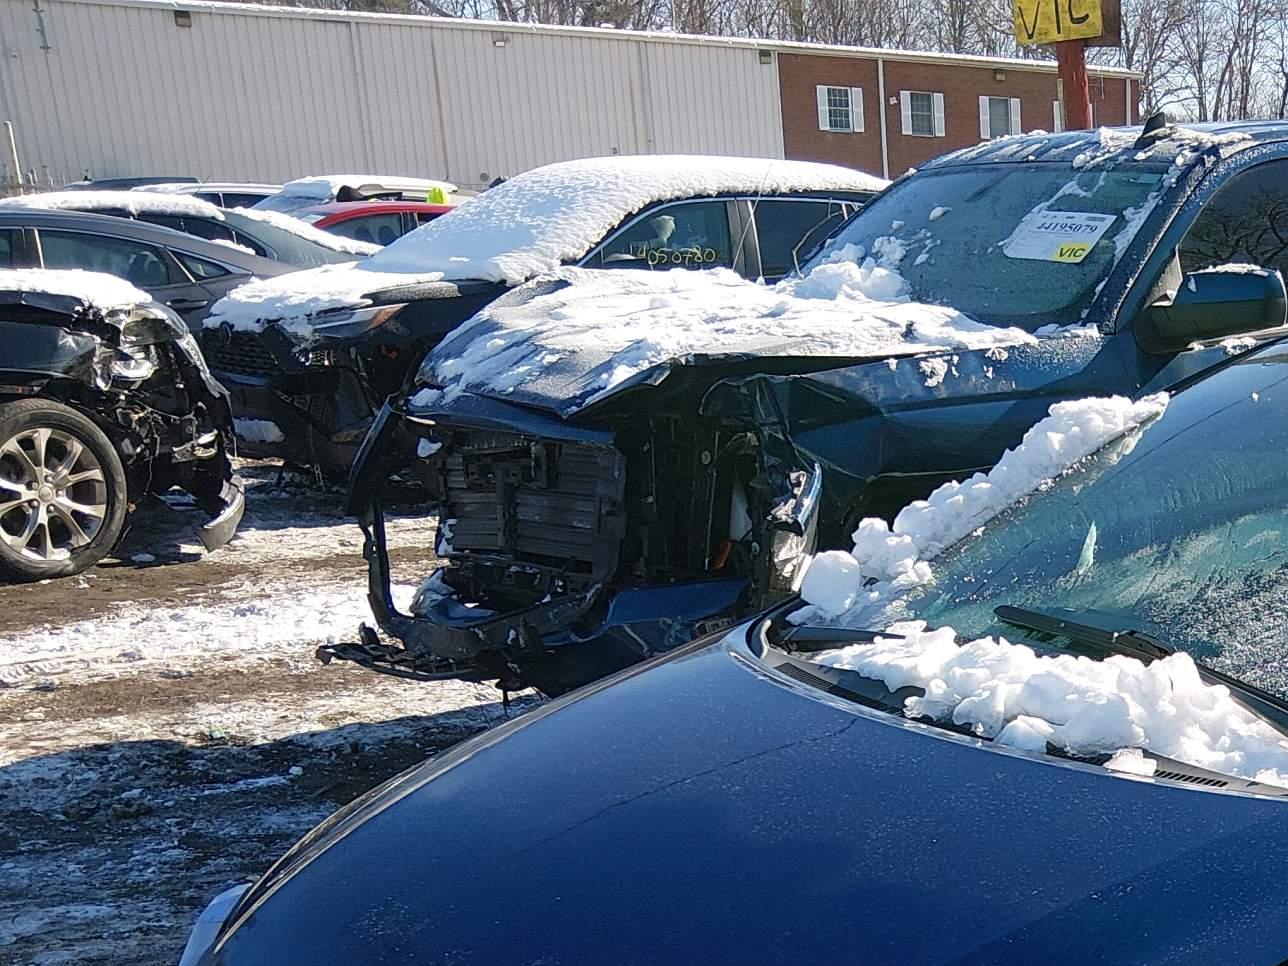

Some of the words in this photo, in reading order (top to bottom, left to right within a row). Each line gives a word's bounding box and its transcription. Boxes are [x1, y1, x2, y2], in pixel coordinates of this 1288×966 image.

[1018, 0, 1090, 39] VIC
[1036, 222, 1099, 234] 44195079
[1059, 247, 1086, 258] VIC
